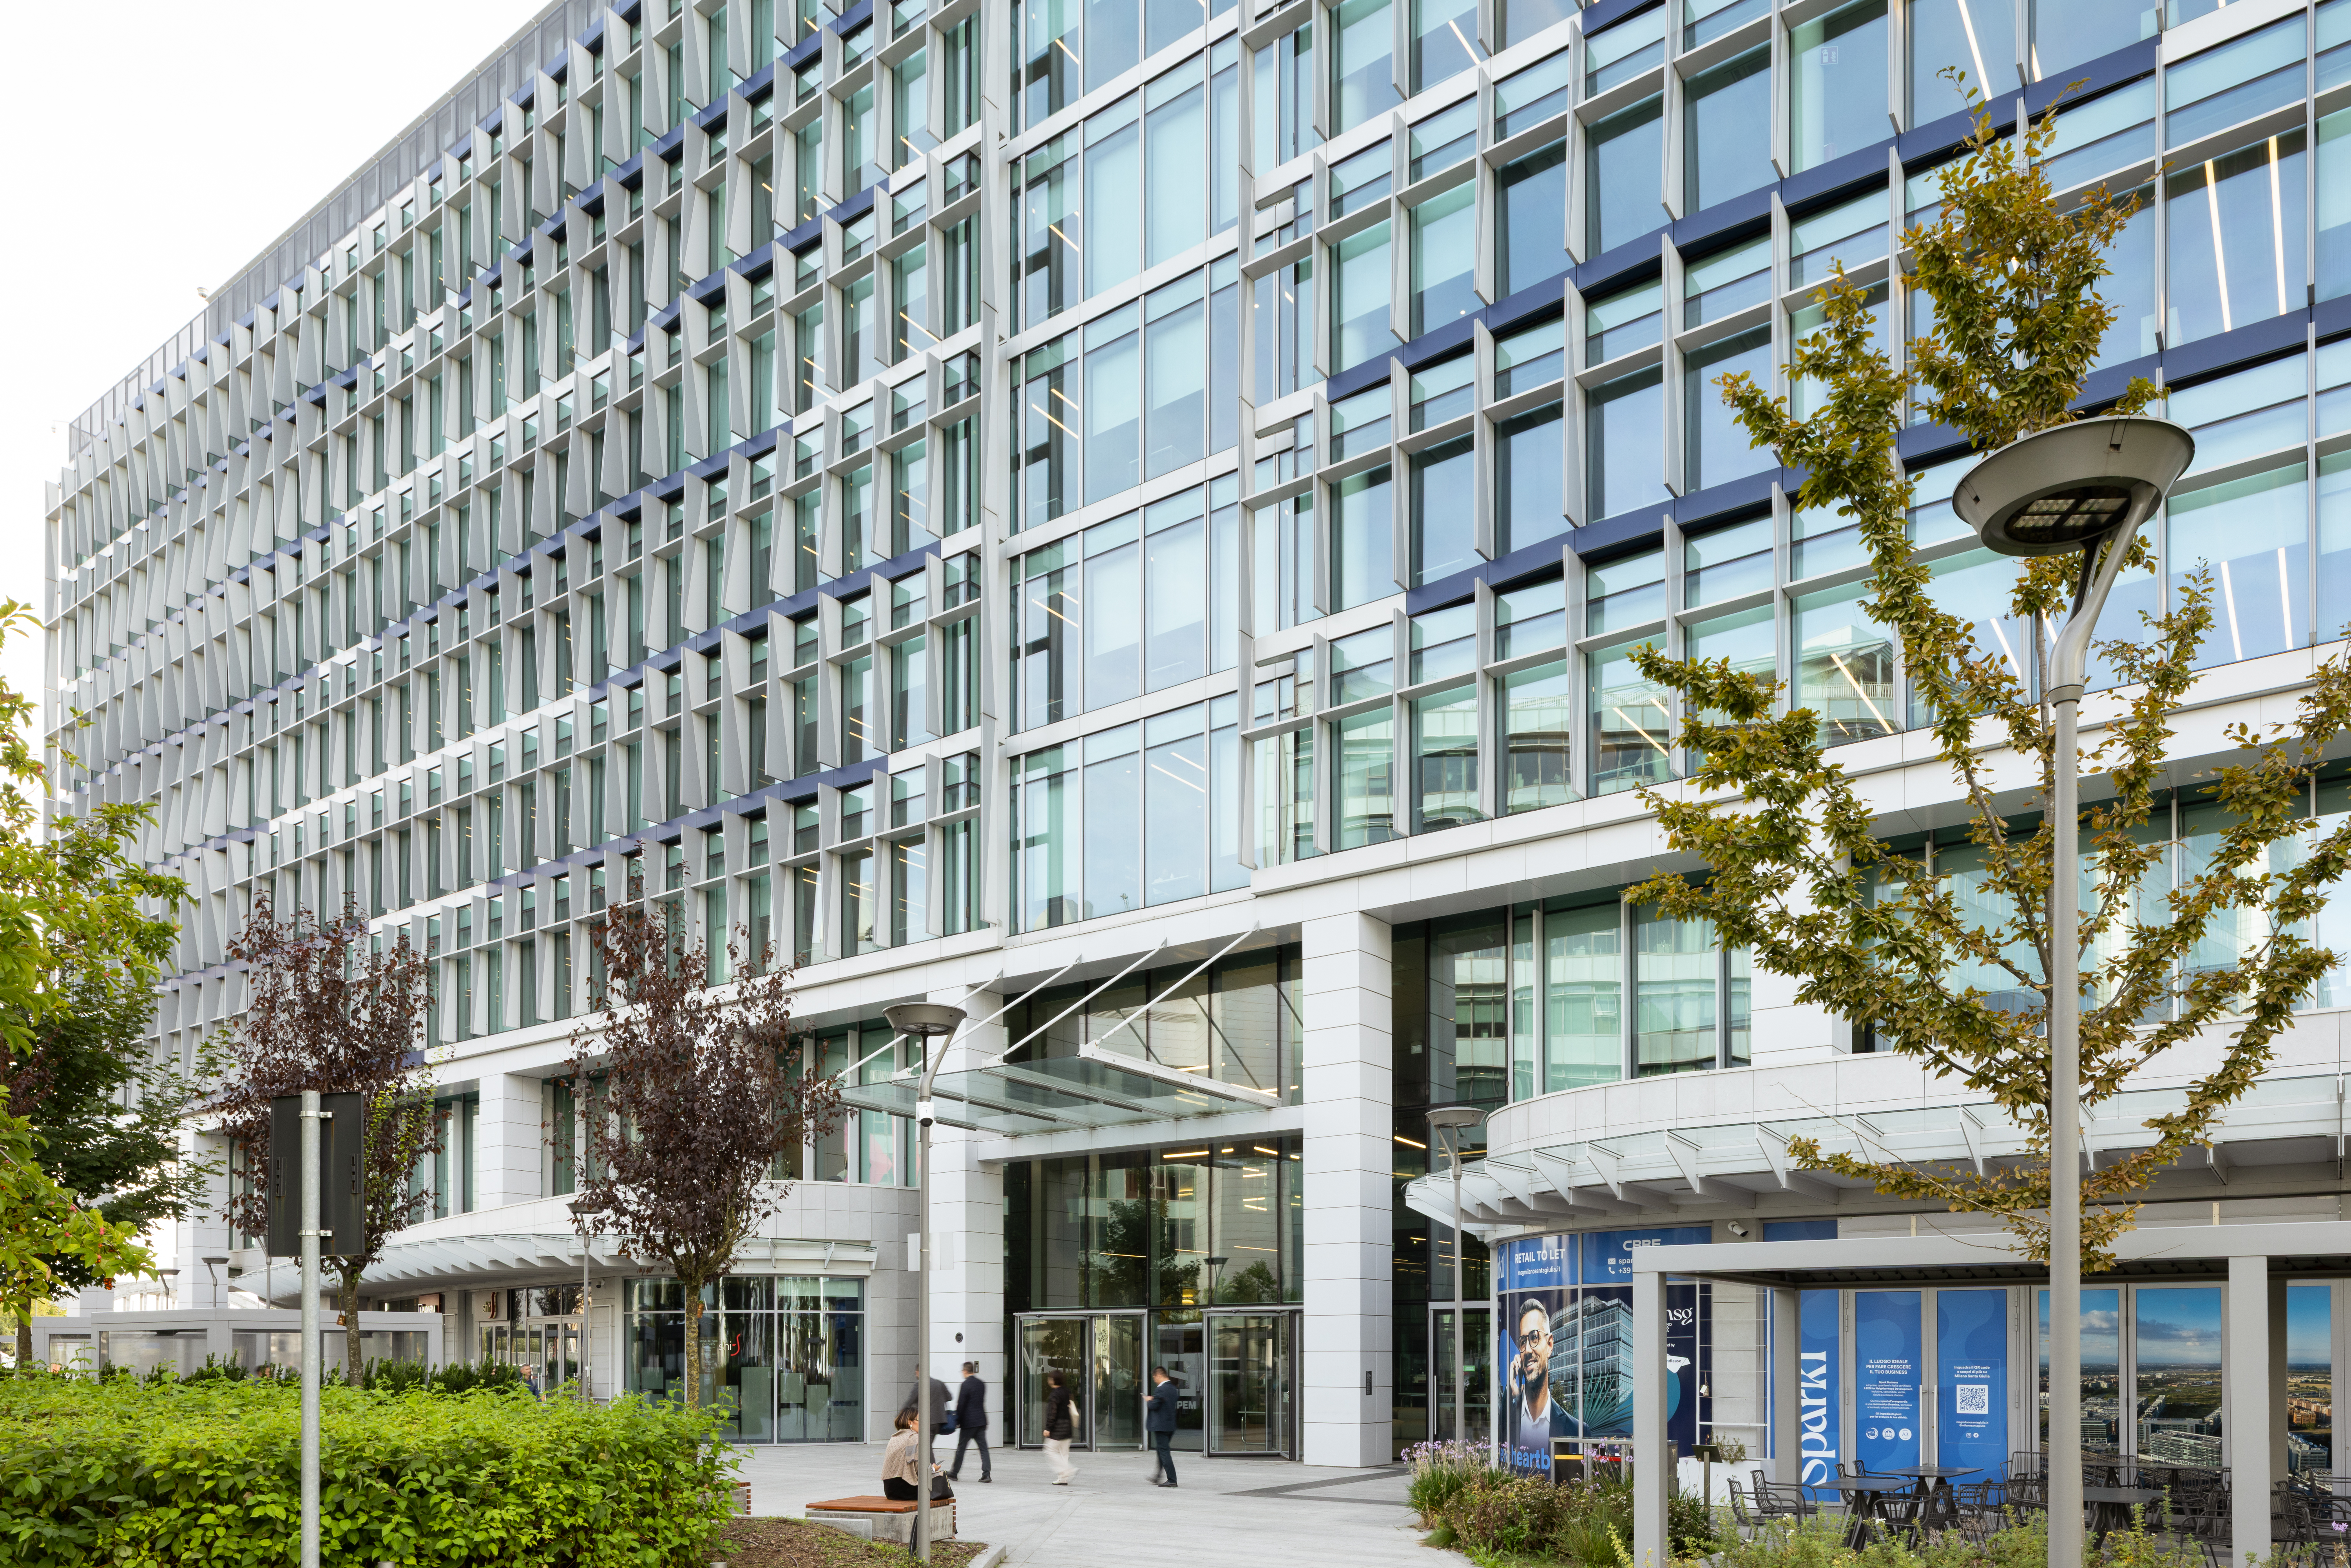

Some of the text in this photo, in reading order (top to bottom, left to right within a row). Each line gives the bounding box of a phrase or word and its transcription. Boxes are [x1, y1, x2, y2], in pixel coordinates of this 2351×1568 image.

[1515, 1248, 1565, 1264] RETAIL TO LET
[1518, 1266, 1561, 1276] msgmilanosantagiulia.it
[1511, 1444, 1550, 1470] heartb
